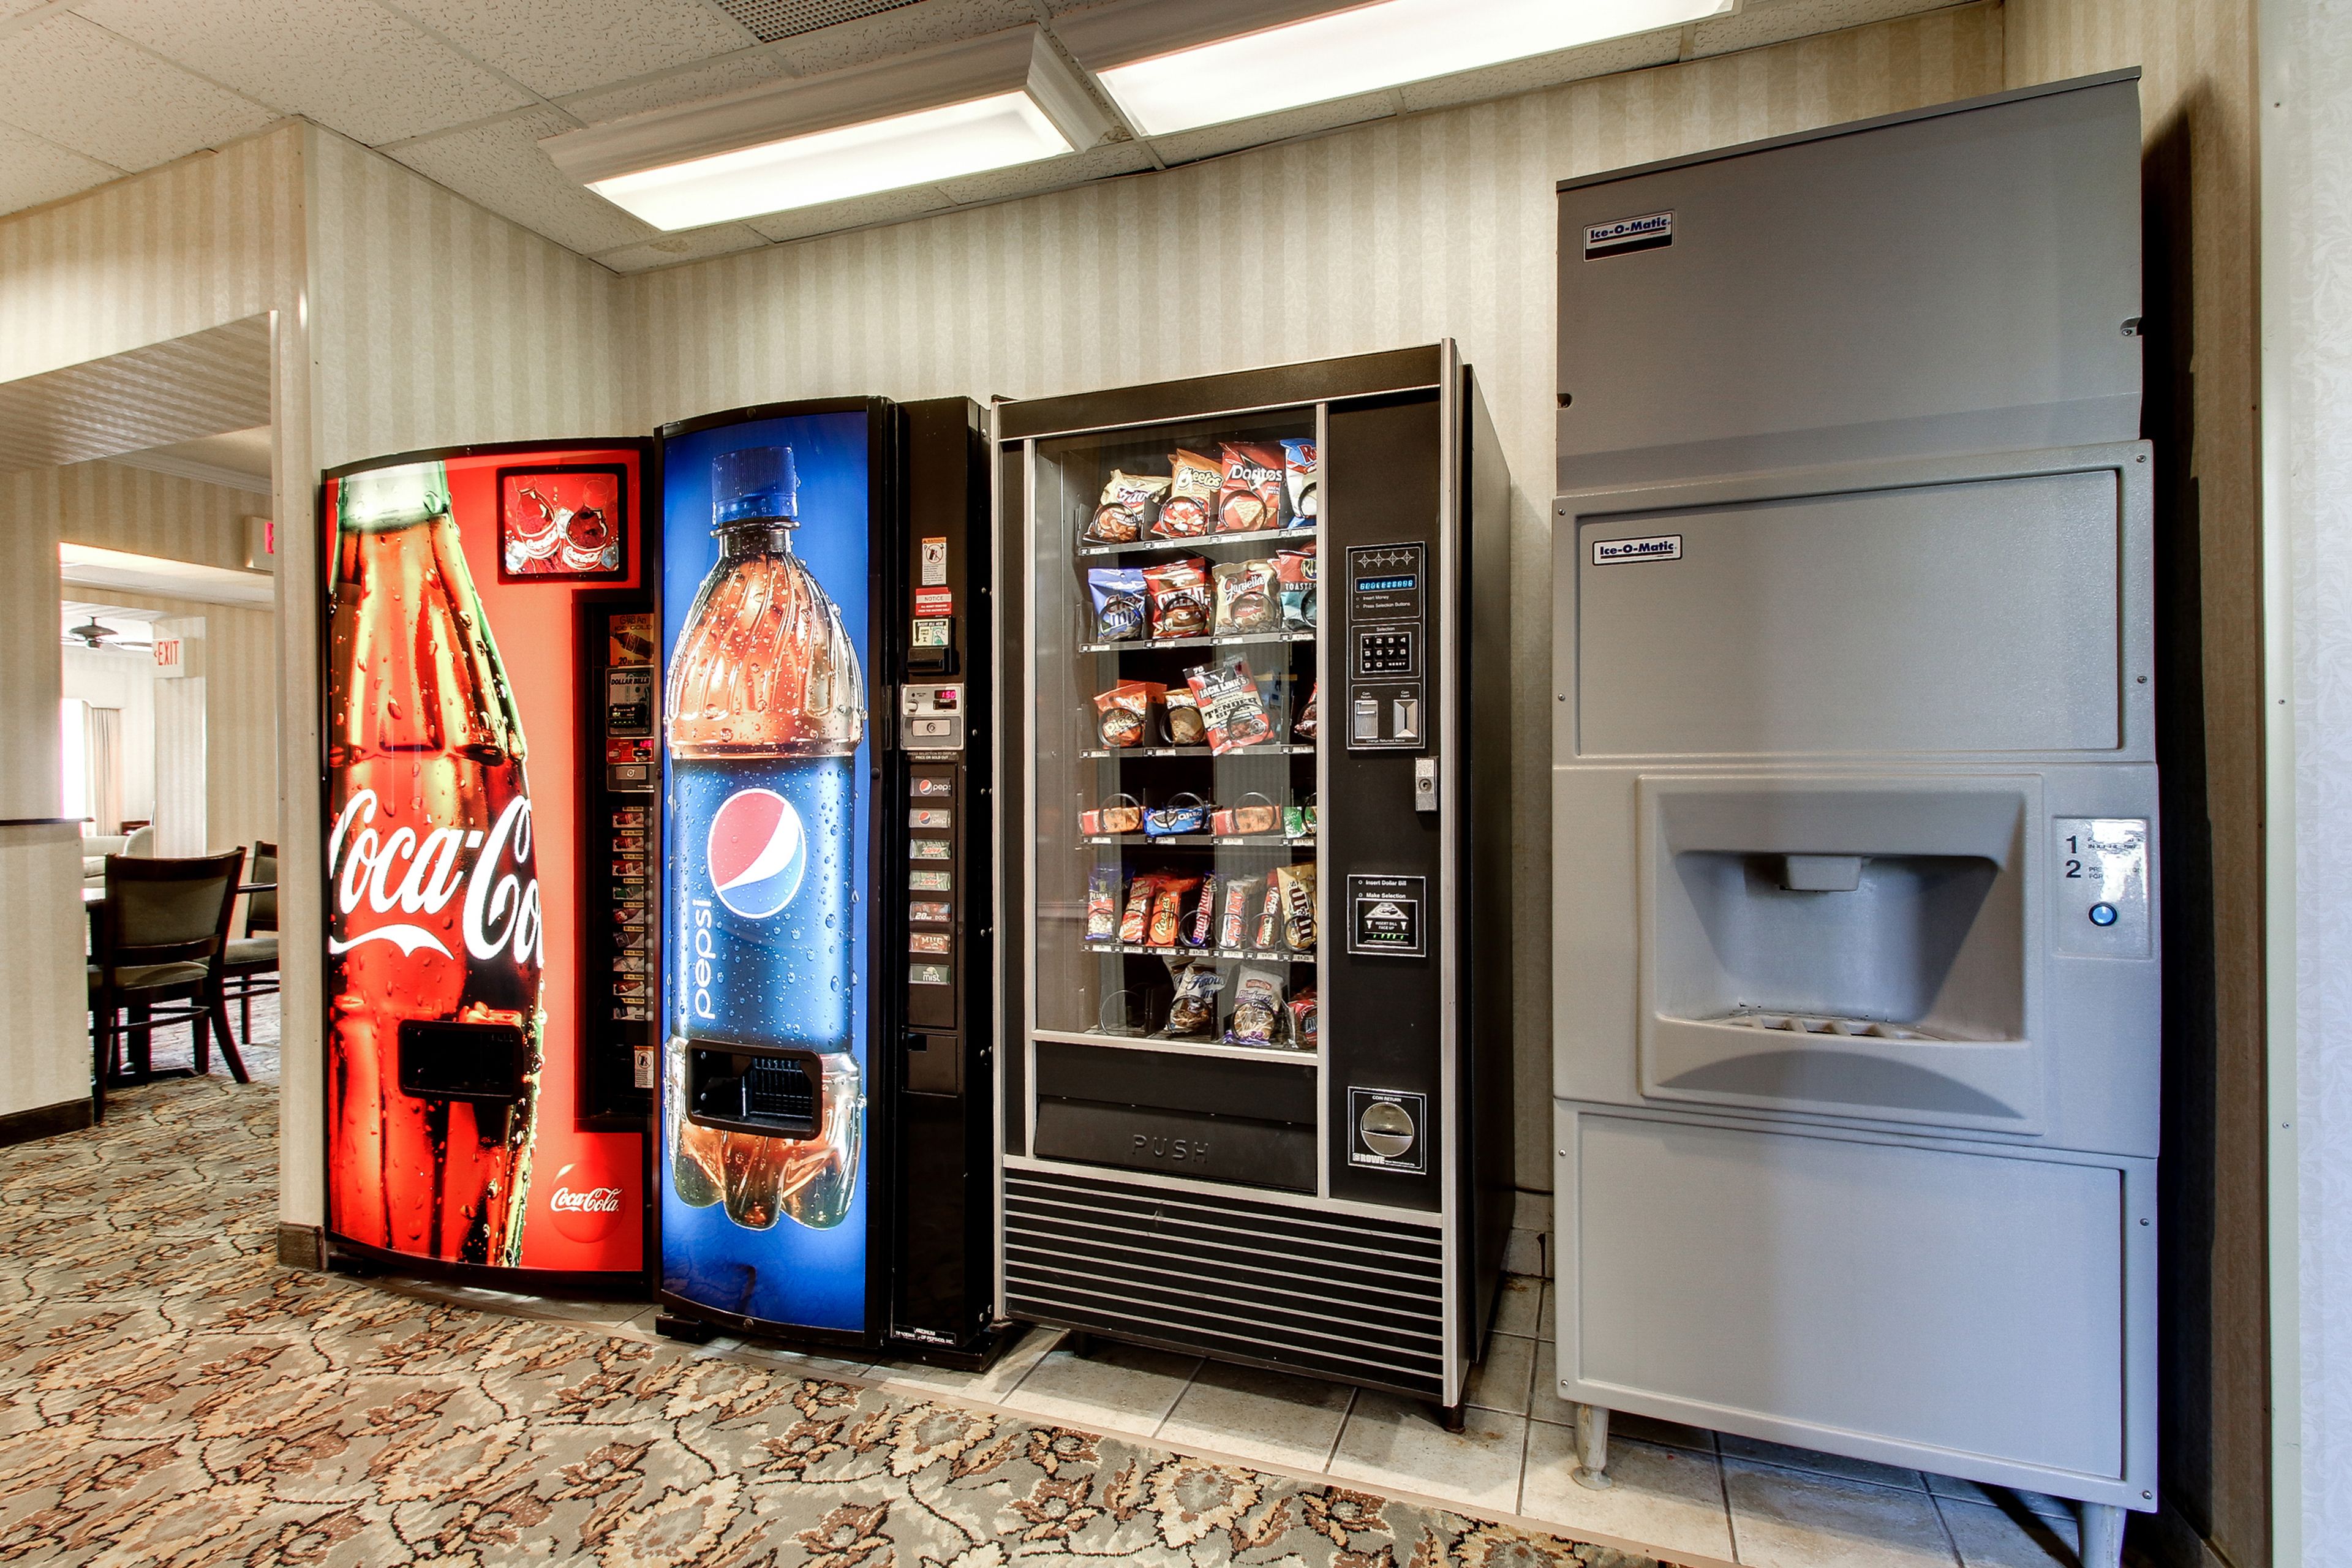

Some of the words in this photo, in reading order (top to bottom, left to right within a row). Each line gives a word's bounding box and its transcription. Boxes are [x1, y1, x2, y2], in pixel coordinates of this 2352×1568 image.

[1590, 217, 1667, 239] Ice-O-Matic
[1175, 467, 1223, 491] Cheetos
[1232, 464, 1283, 482] Doritos
[1118, 486, 1151, 503] Frito
[1599, 541, 1675, 555] Ice-O-Matic
[1302, 559, 1317, 578] RI
[1285, 582, 1317, 592] TOASTE
[158, 641, 179, 666] EXIT
[1199, 685, 1219, 699] JACK
[1219, 676, 1248, 692] LINK'S
[1205, 697, 1257, 720] TENDER
[1216, 704, 1251, 719] BITS
[933, 783, 951, 792] pep
[1178, 812, 1202, 821] OREO
[2065, 835, 2077, 854] 1
[2065, 859, 2081, 878] 2
[1154, 897, 1170, 937] Reese's
[921, 937, 944, 945] MUG
[692, 898, 717, 1020] pepsi
[1133, 1134, 1208, 1163] PUSH
[1360, 1153, 1385, 1164] ROWE
[550, 1187, 620, 1213] Coca-Cola
